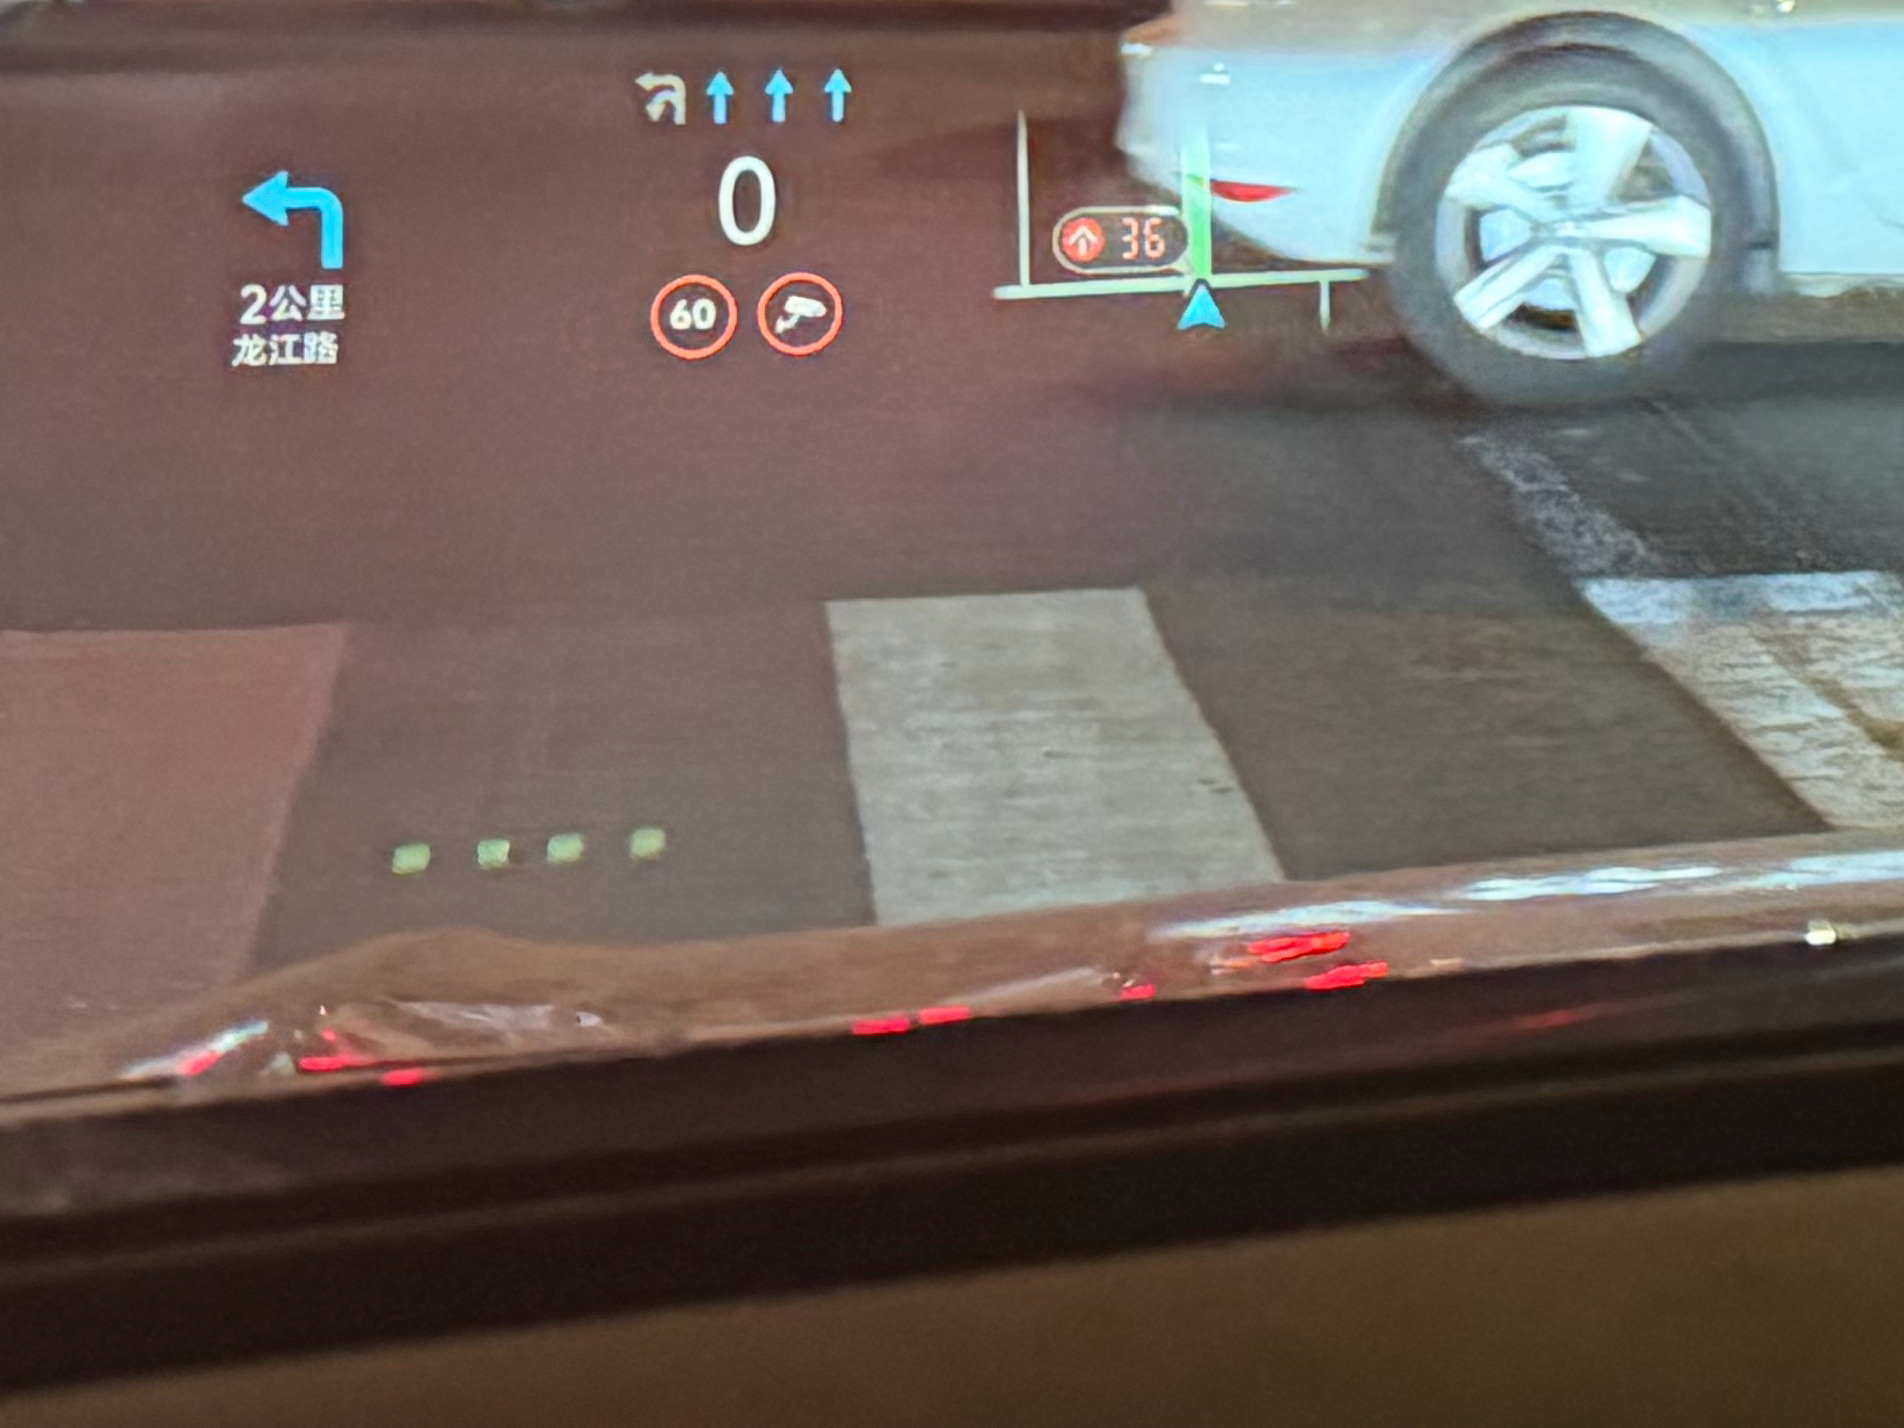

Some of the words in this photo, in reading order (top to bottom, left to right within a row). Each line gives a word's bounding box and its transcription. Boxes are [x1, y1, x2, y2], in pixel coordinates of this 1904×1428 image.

[718, 155, 776, 246] 0
[1121, 216, 1166, 260] 36
[239, 283, 346, 326] 2公里
[669, 297, 717, 331] 60
[231, 330, 340, 368] 龙江路
